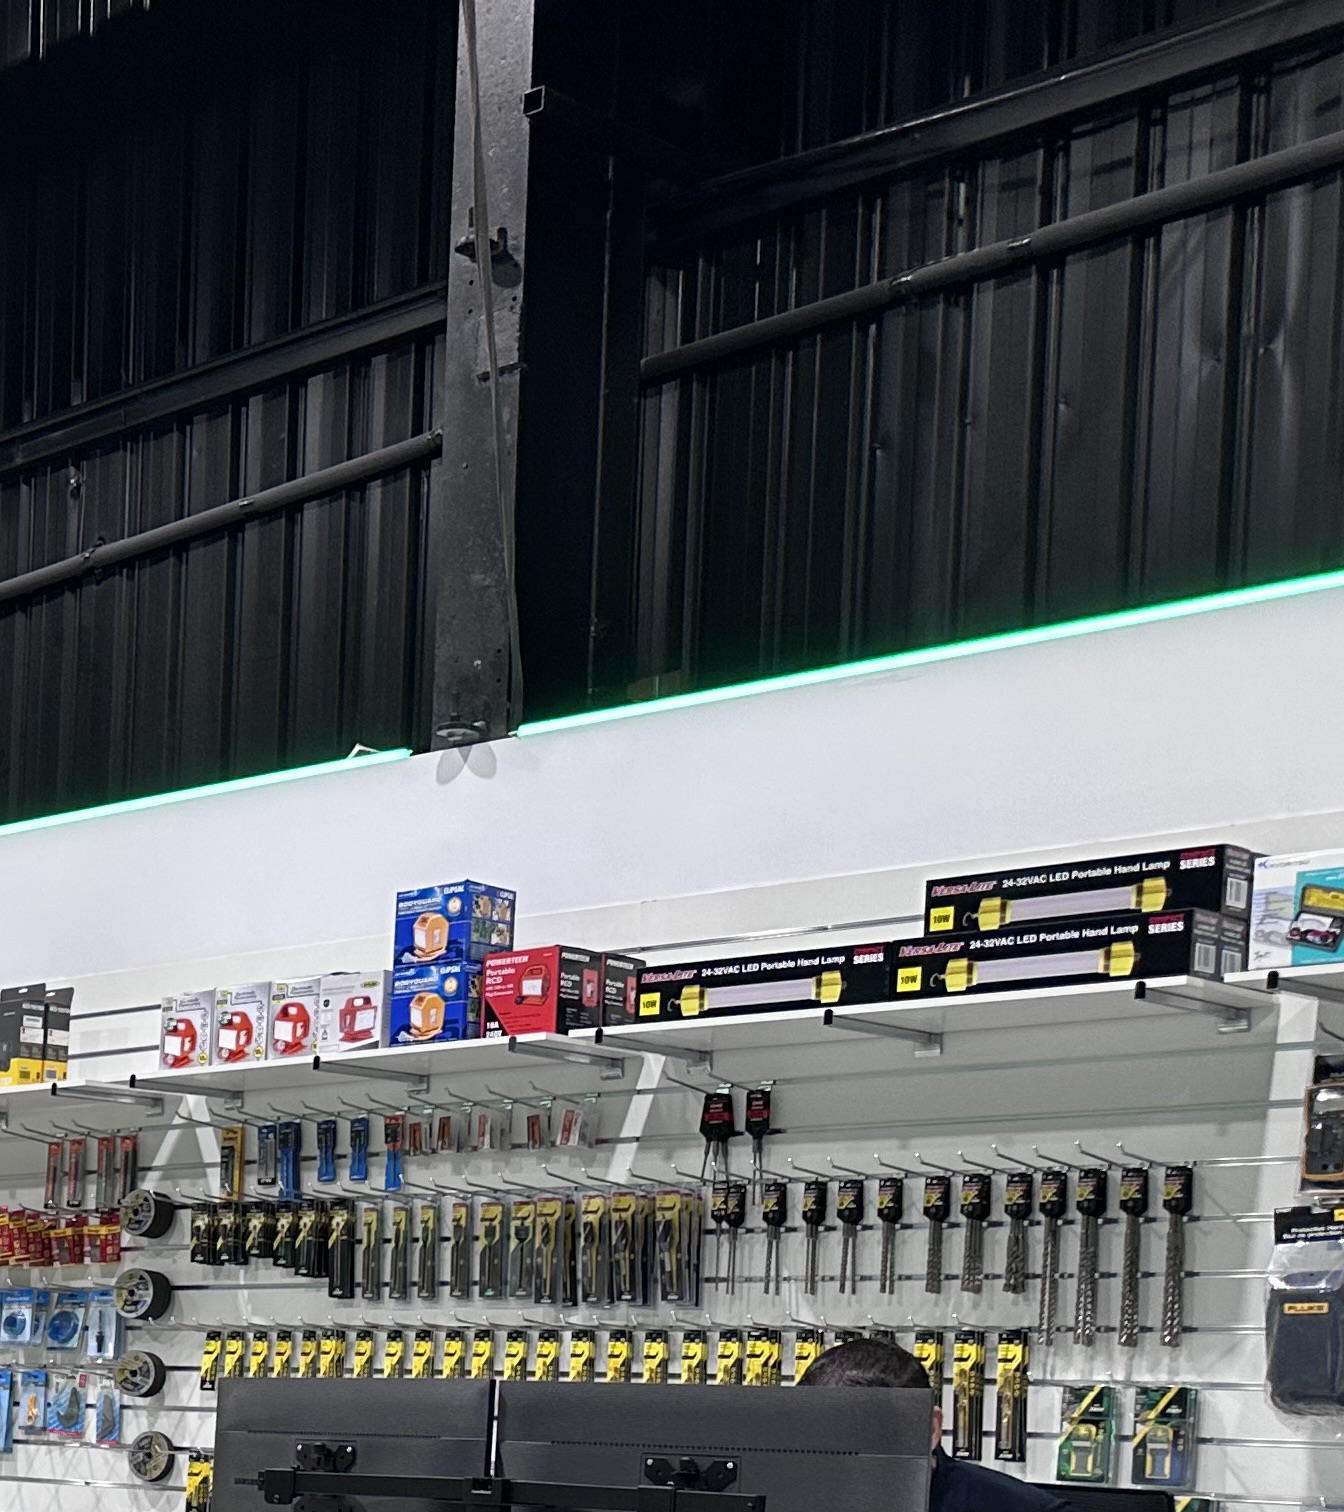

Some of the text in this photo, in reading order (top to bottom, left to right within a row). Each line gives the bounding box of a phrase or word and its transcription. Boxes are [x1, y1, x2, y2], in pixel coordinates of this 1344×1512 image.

[1002, 875, 1048, 889] 24-32VAC
[1049, 871, 1070, 883] LED
[1071, 866, 1112, 881] Portable
[1114, 863, 1141, 875] Hand
[1142, 860, 1171, 873] Lamp
[1179, 857, 1216, 870] SERIES
[932, 914, 952, 925] 10W
[969, 938, 1015, 951] 24-32VAC
[1016, 934, 1038, 946] LED
[1039, 930, 1080, 943] Portable
[1081, 926, 1109, 938] Hand
[1110, 923, 1140, 937] Lamp
[1147, 921, 1185, 936] SERIES
[485, 954, 531, 969] POWERTECH
[852, 953, 885, 965] SERIES
[485, 967, 517, 978] Portable
[485, 976, 503, 986] RCD
[900, 974, 919, 986] 10W
